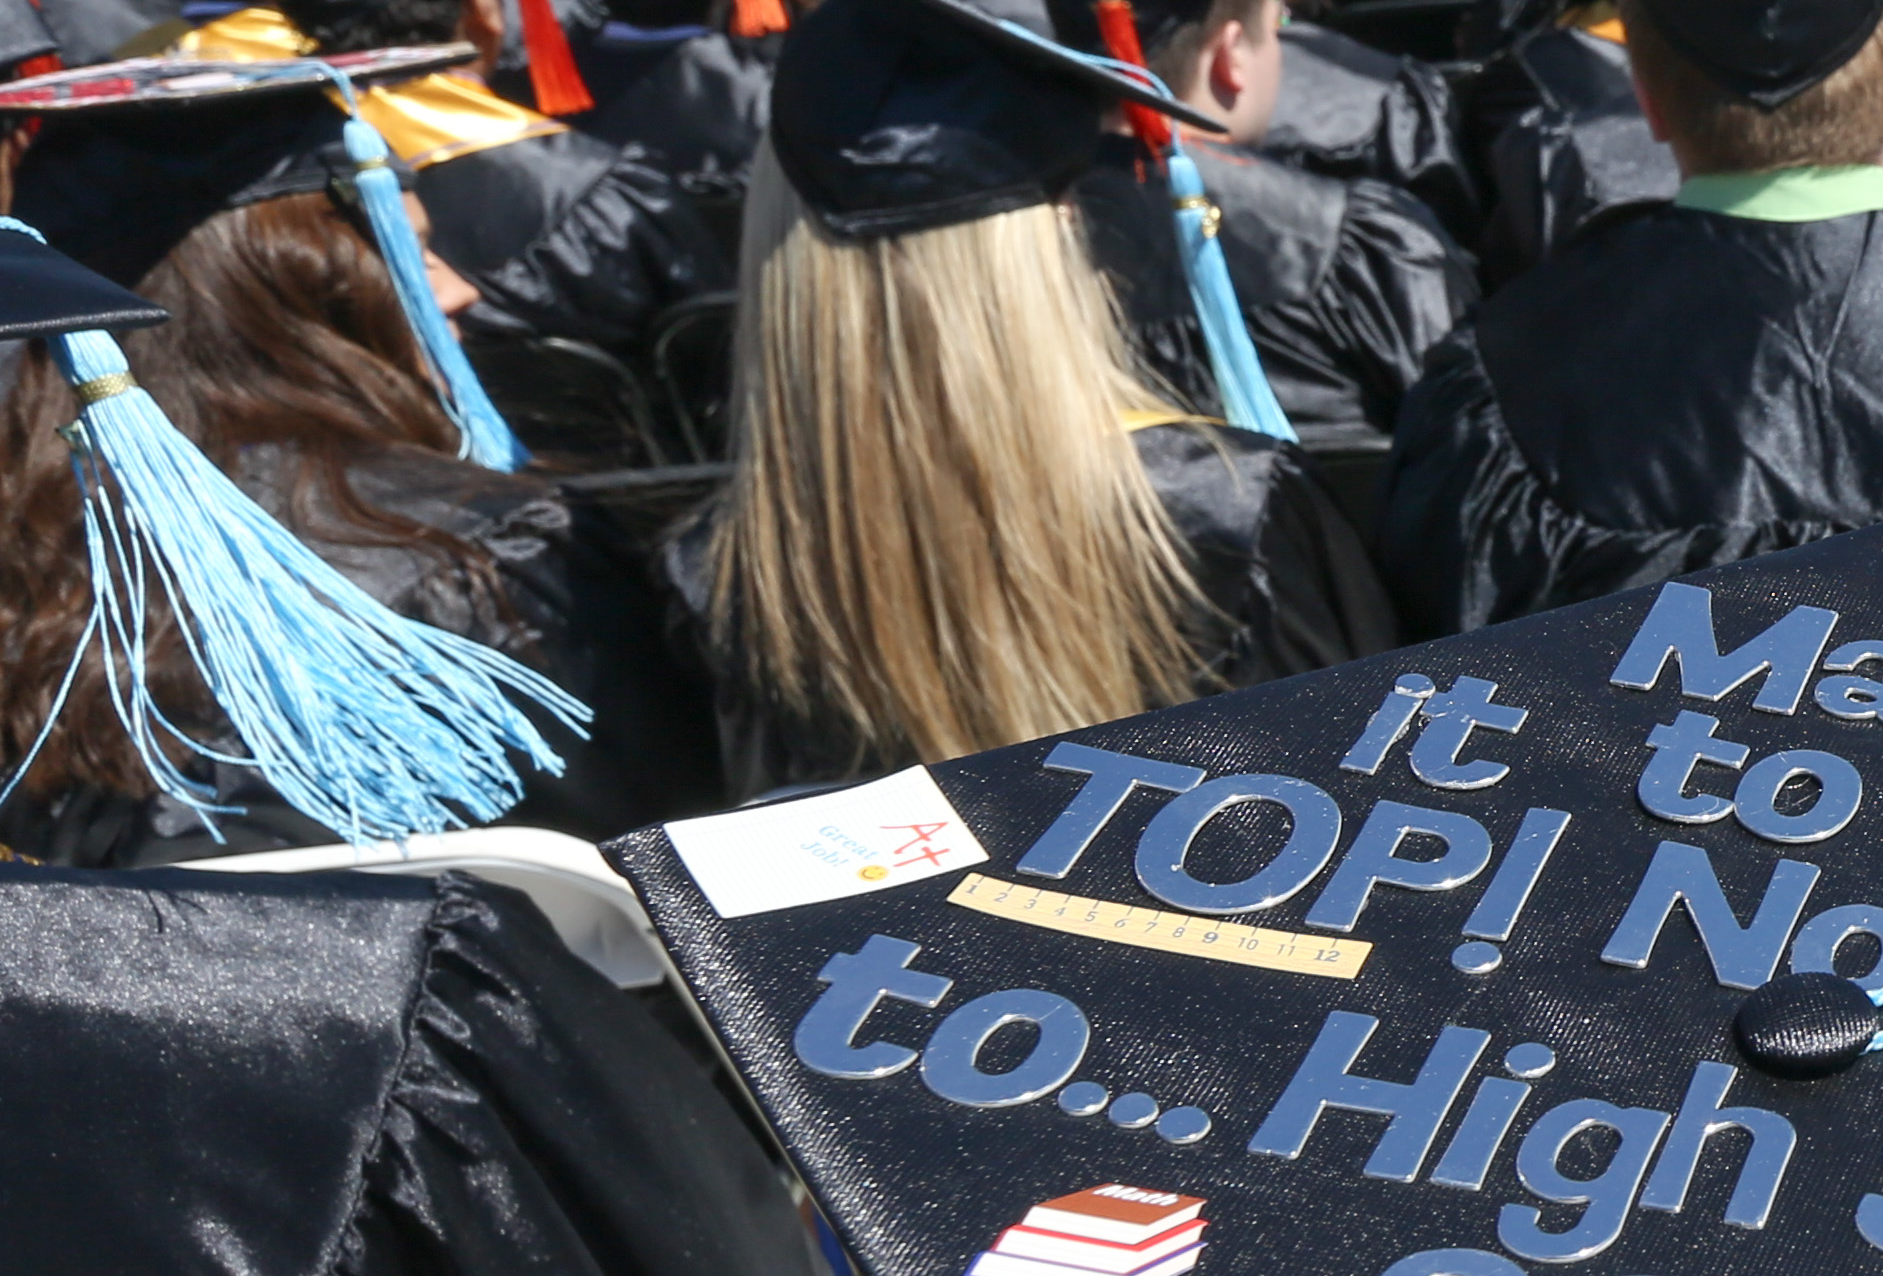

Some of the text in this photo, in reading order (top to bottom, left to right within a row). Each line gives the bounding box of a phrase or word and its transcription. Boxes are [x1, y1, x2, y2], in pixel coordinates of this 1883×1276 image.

[1338, 672, 1530, 791] it
[1635, 710, 1863, 844] to
[800, 841, 849, 867] Job!
[818, 825, 880, 861] Great
[879, 821, 951, 868] A+
[1016, 742, 1572, 975] TOP!
[966, 884, 1341, 963] 1 2 3 4 5 6 7 8 9 10 11 12
[794, 934, 1212, 1145] to...
[1247, 1010, 1796, 1263] High
[1092, 1184, 1179, 1207] Math
